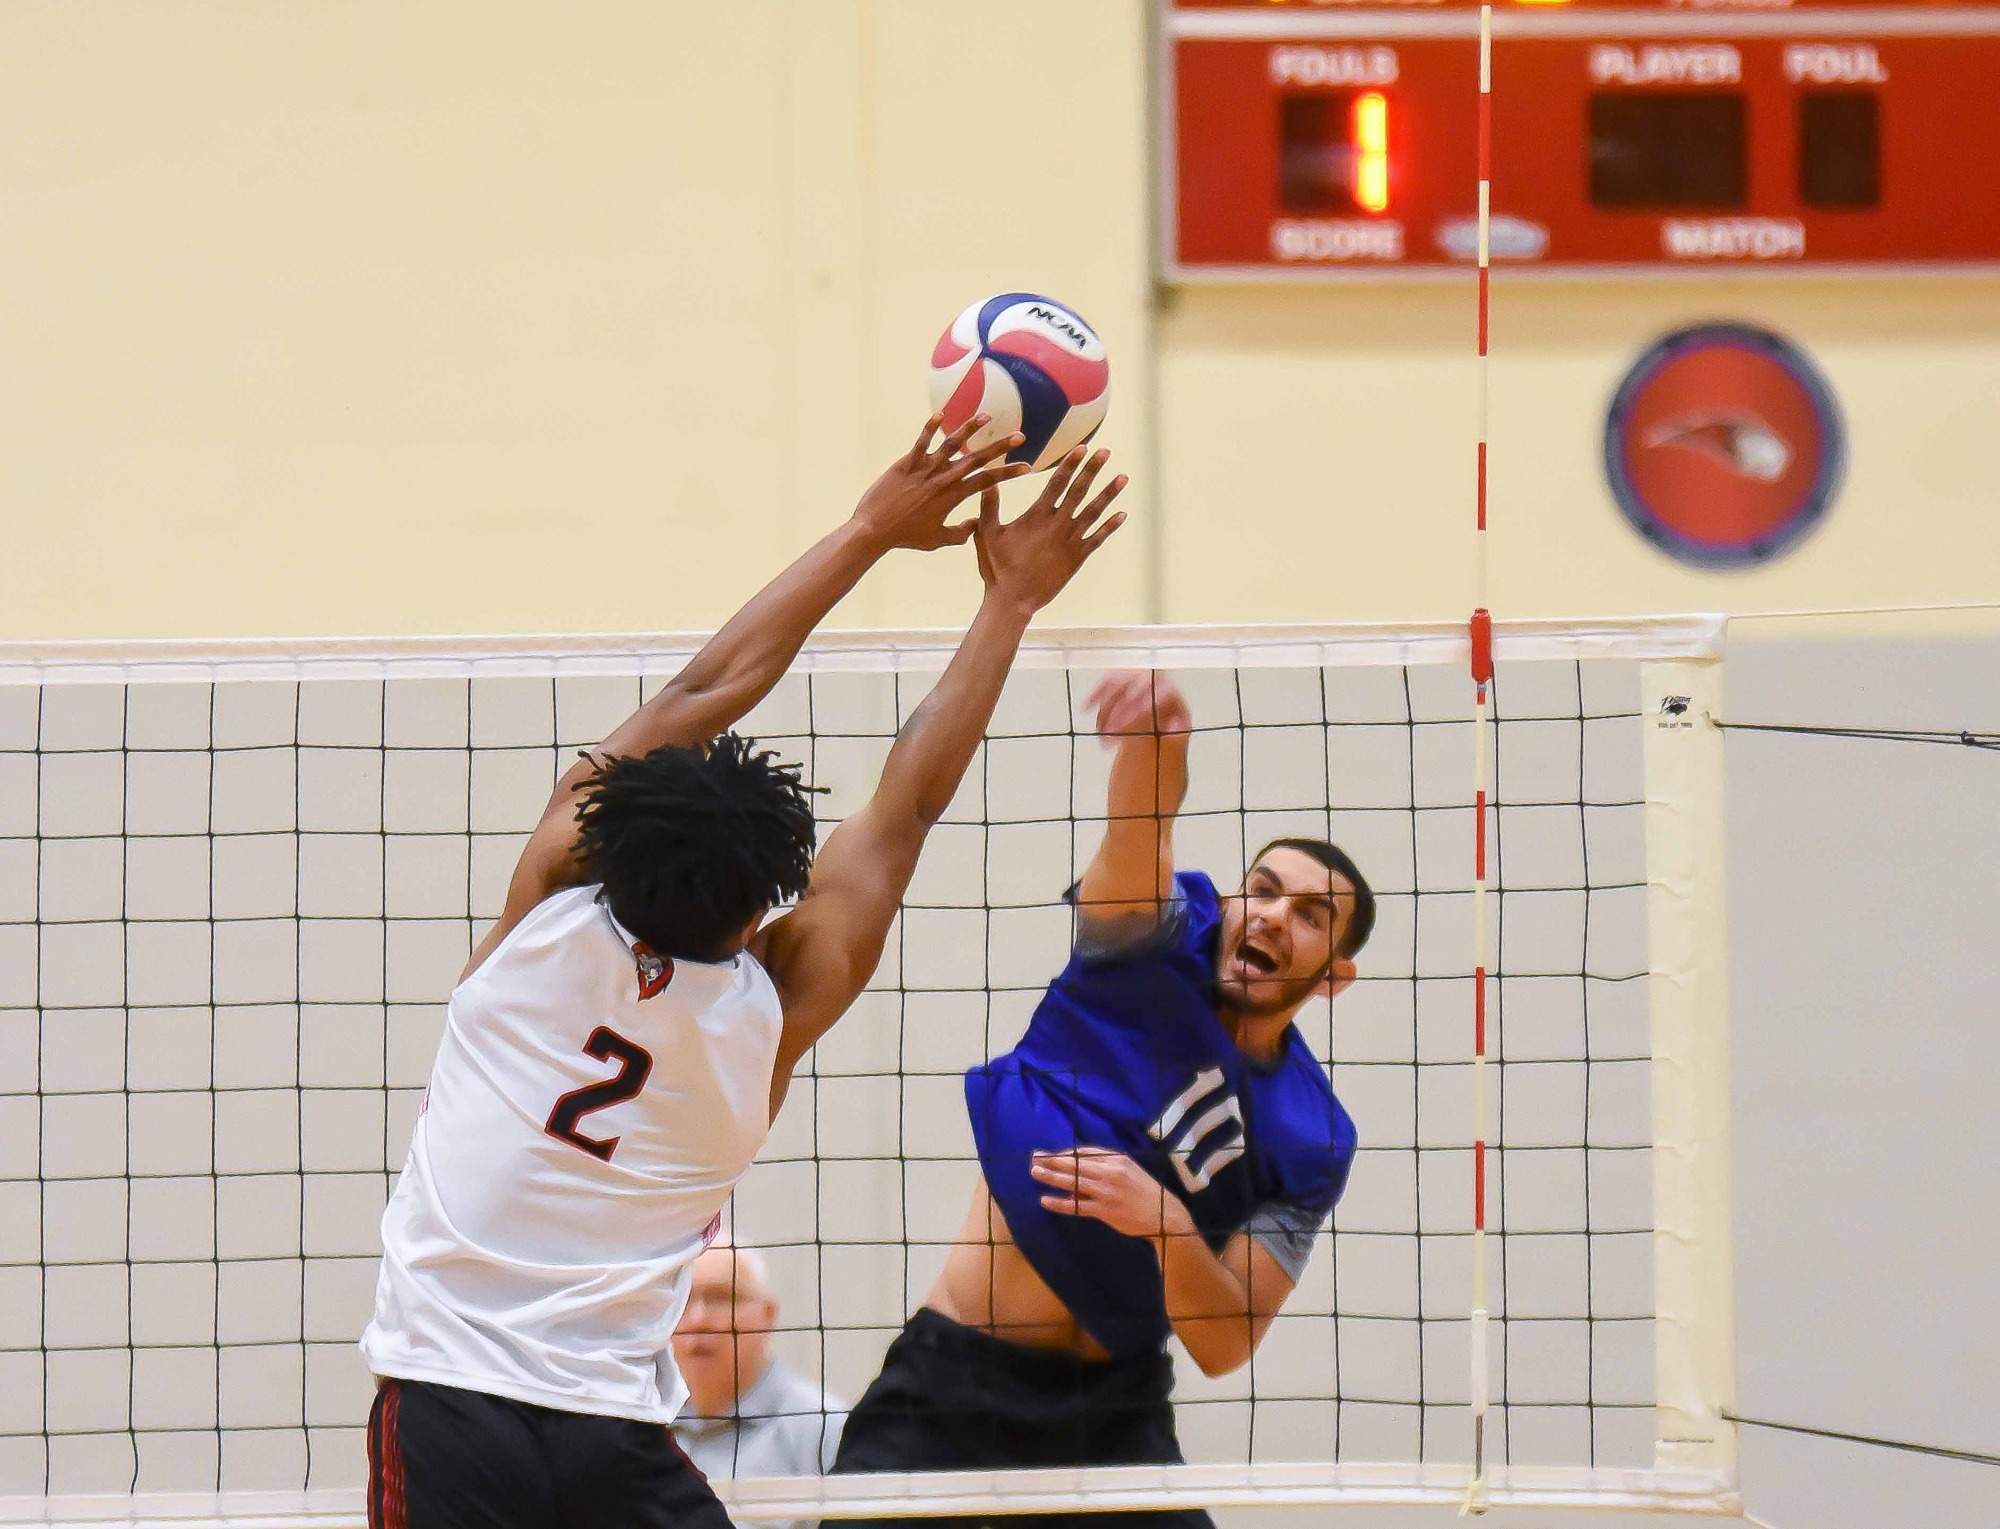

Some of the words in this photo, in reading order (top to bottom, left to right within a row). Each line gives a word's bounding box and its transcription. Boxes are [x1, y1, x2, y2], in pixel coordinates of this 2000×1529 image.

[1590, 46, 1741, 84] PLAYER
[1785, 46, 1888, 84] FOUL
[1355, 92, 1388, 212] 1
[1271, 221, 1403, 260] SCORE
[1663, 220, 1805, 259] MATCH
[1027, 306, 1087, 350] NCAA
[544, 1025, 653, 1163] 2
[1147, 1066, 1245, 1193] 10
